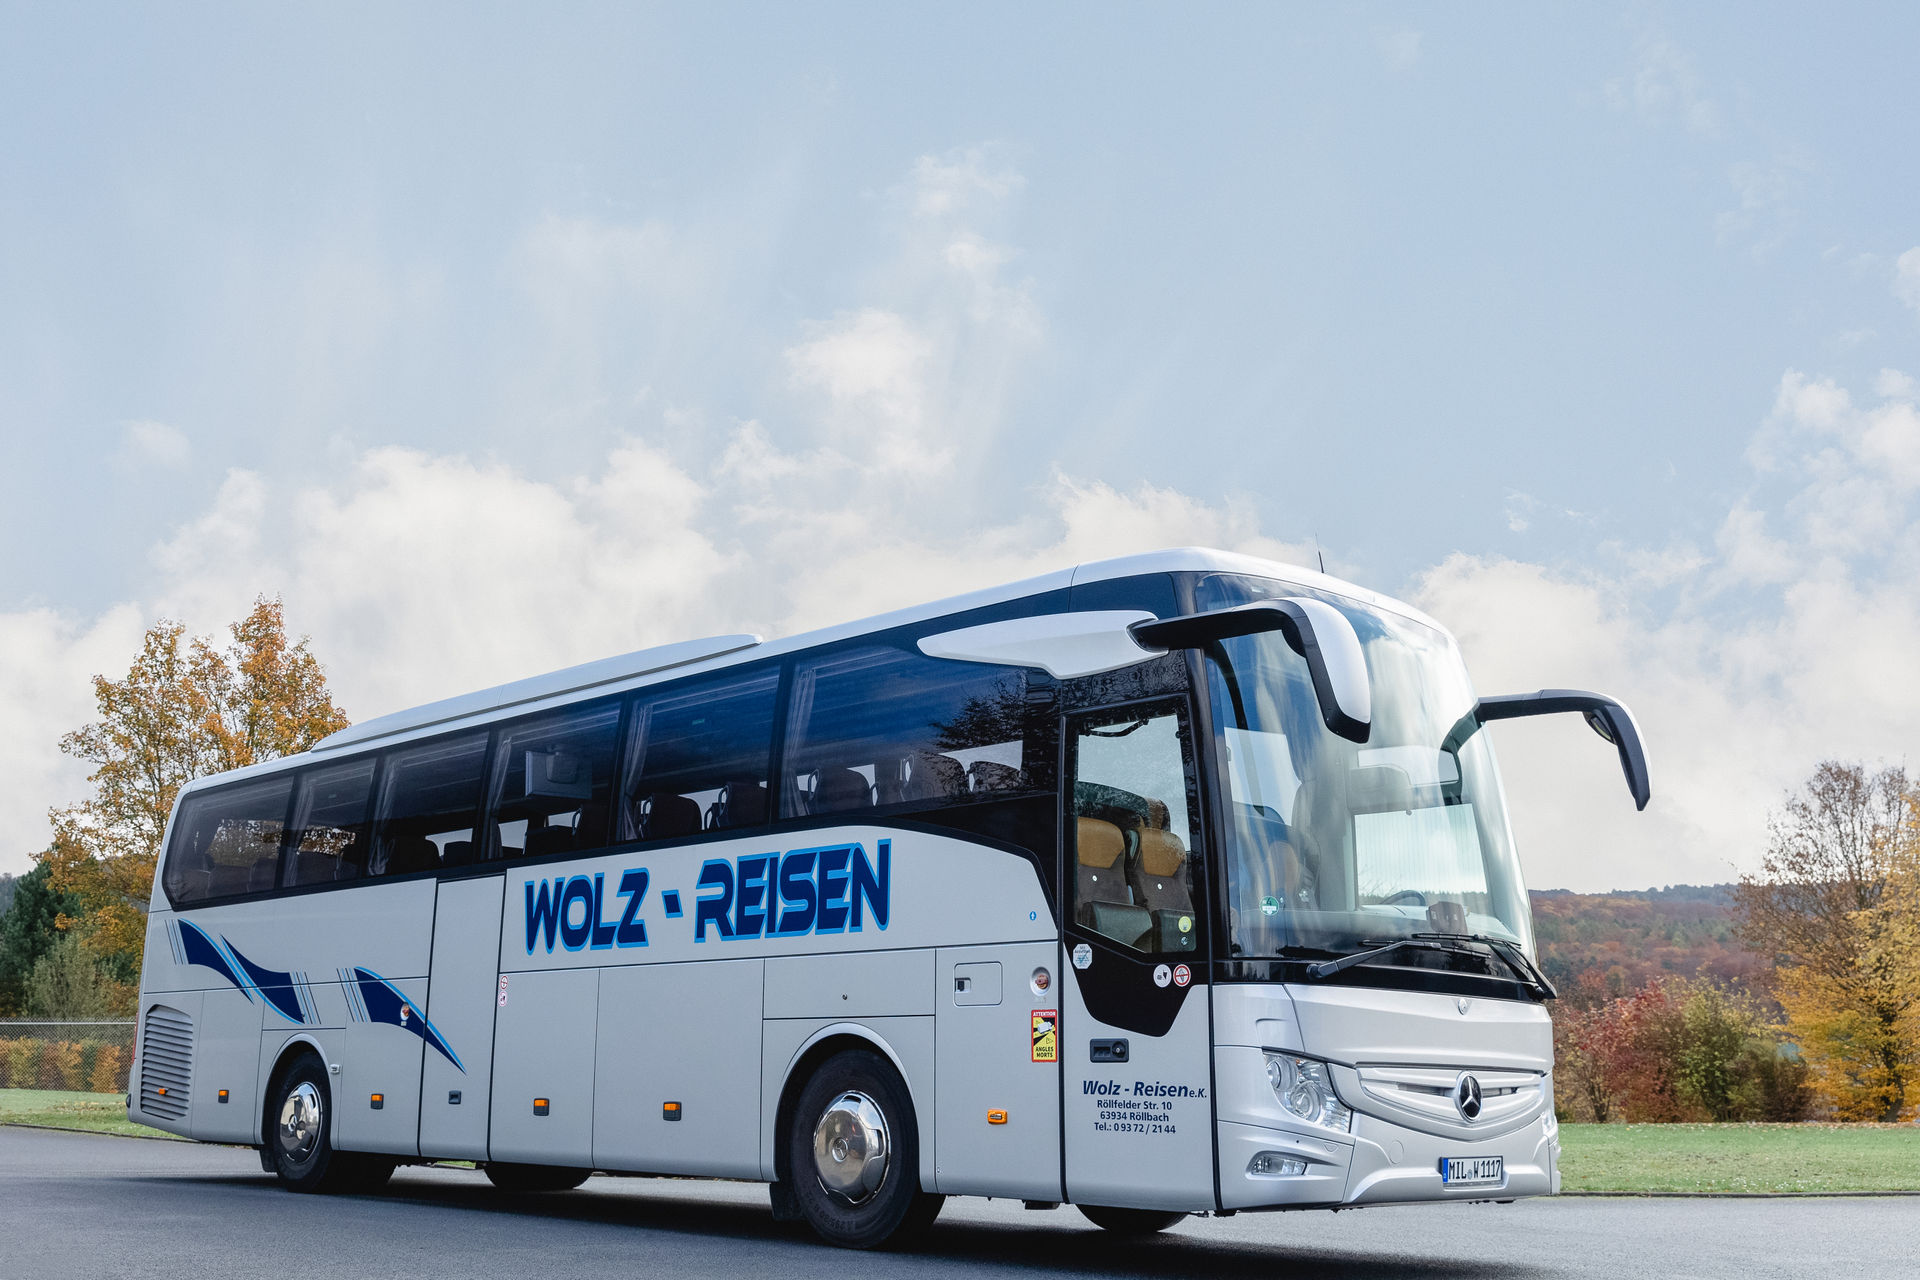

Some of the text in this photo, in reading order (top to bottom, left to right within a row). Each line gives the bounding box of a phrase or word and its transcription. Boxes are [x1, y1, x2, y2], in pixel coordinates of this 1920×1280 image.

[525, 867, 649, 955] WOLZ
[694, 838, 891, 943] REISEN
[1083, 1080, 1121, 1095] Wolz
[1133, 1081, 1188, 1097] Reisen
[1189, 1088, 1207, 1098] e.K.
[1097, 1100, 1172, 1111] Röllfelder Str. 10
[1100, 1111, 1170, 1122] 63934 Röllbach
[1094, 1122, 1112, 1131] Tel.:
[1449, 1161, 1467, 1179] MIL
